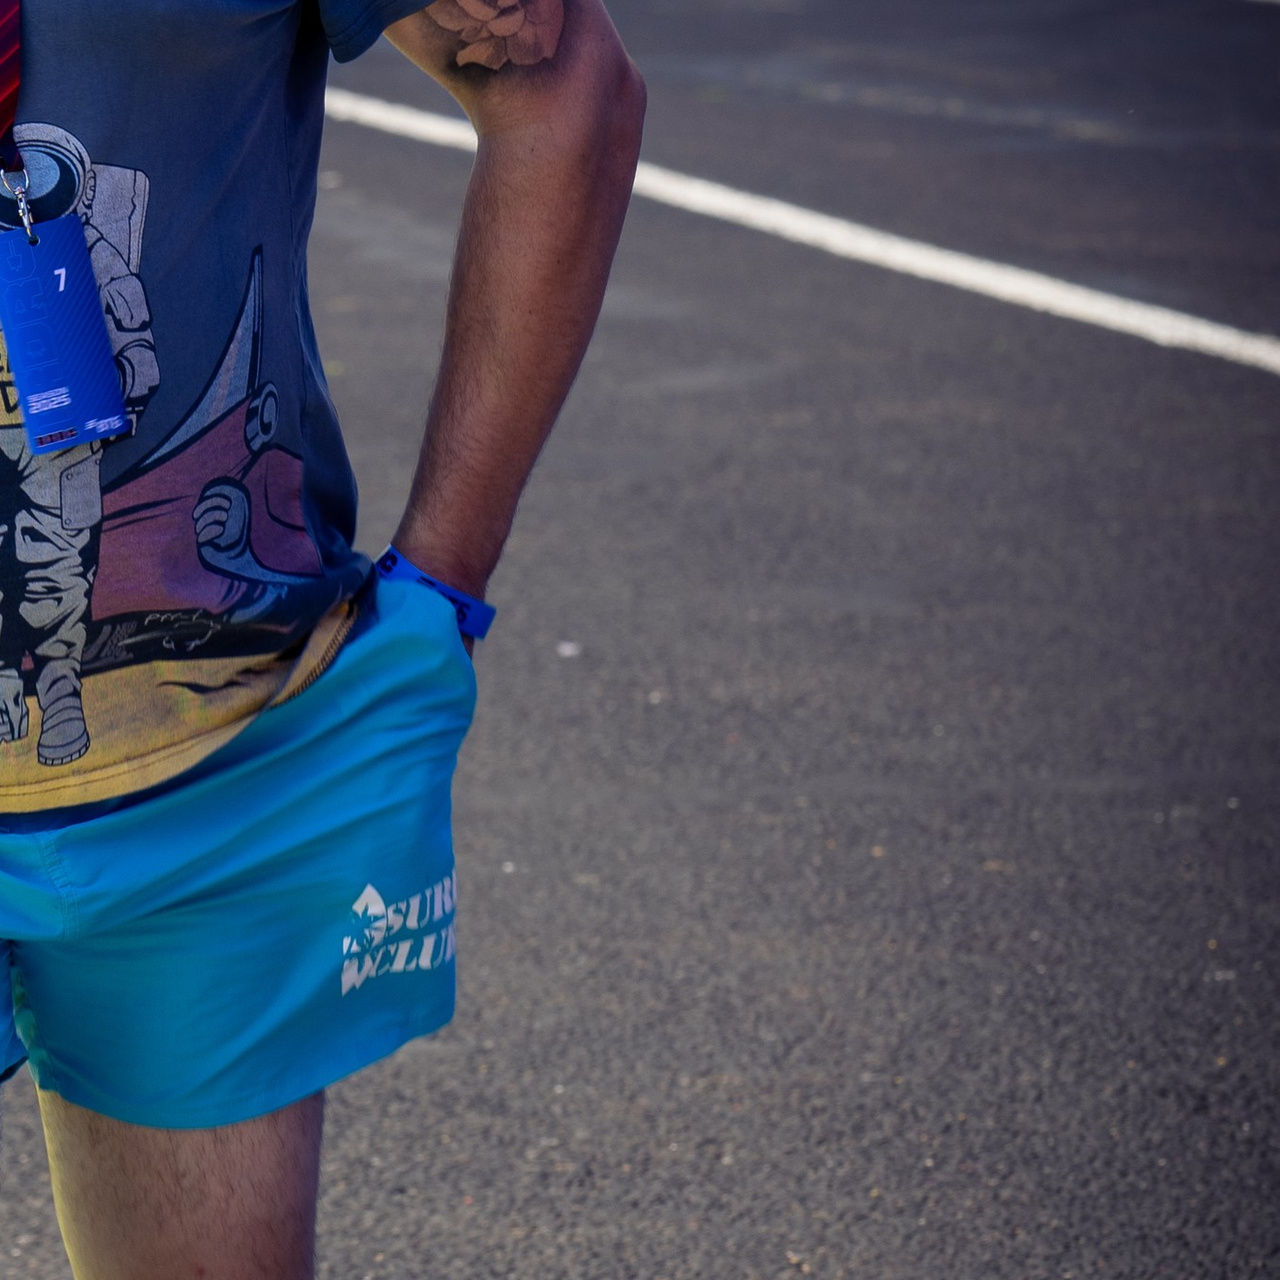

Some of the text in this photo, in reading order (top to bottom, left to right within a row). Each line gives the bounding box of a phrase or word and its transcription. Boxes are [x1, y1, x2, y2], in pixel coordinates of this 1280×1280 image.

[53, 267, 67, 292] 7
[387, 870, 457, 937] SUR
[371, 925, 457, 977] CLU
